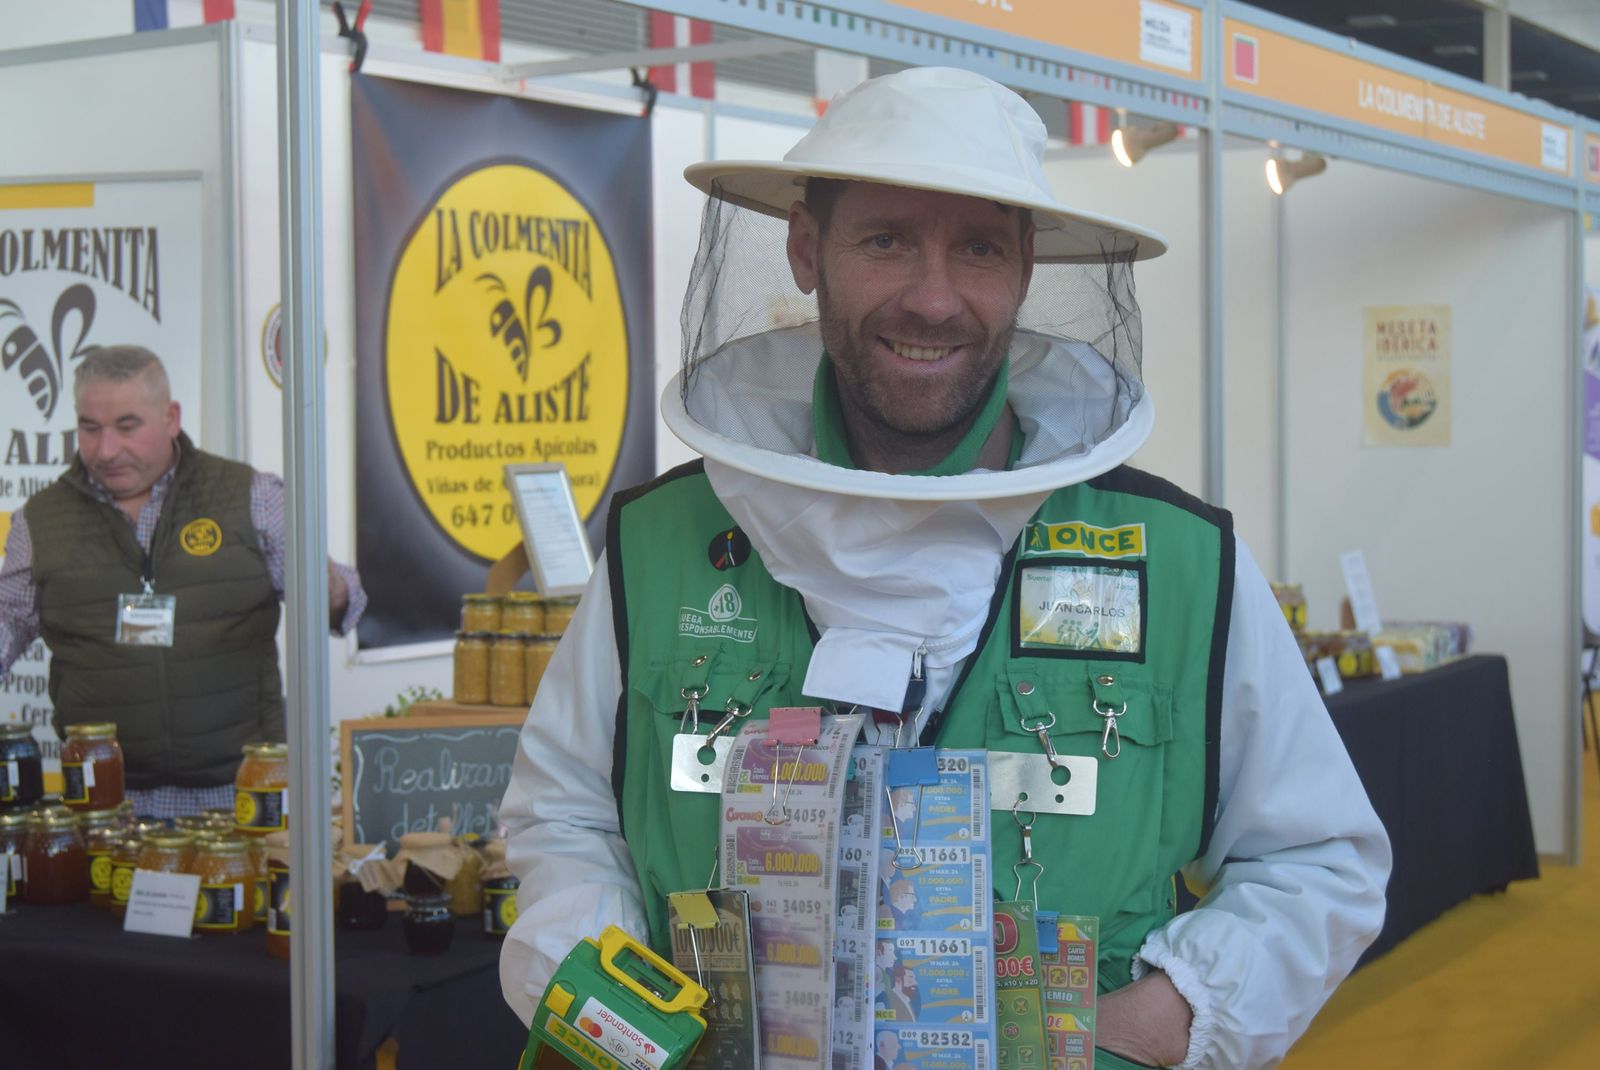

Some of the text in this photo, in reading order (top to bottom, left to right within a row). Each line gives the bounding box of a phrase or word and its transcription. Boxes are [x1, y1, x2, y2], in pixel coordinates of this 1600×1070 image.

[434, 208, 593, 302] LA COLMENITA
[434, 345, 592, 424] DE ALISTE
[426, 440, 525, 460] Productos
[474, 476, 493, 492] de
[1056, 527, 1135, 552] ONCE
[1039, 601, 1126, 618] JUAN CARLOS
[680, 623, 753, 639] ESPONSABLEMENTE
[920, 848, 967, 862] 11661
[920, 939, 968, 953] 11661
[596, 1008, 645, 1047] Santander
[920, 1031, 970, 1046] 82582
